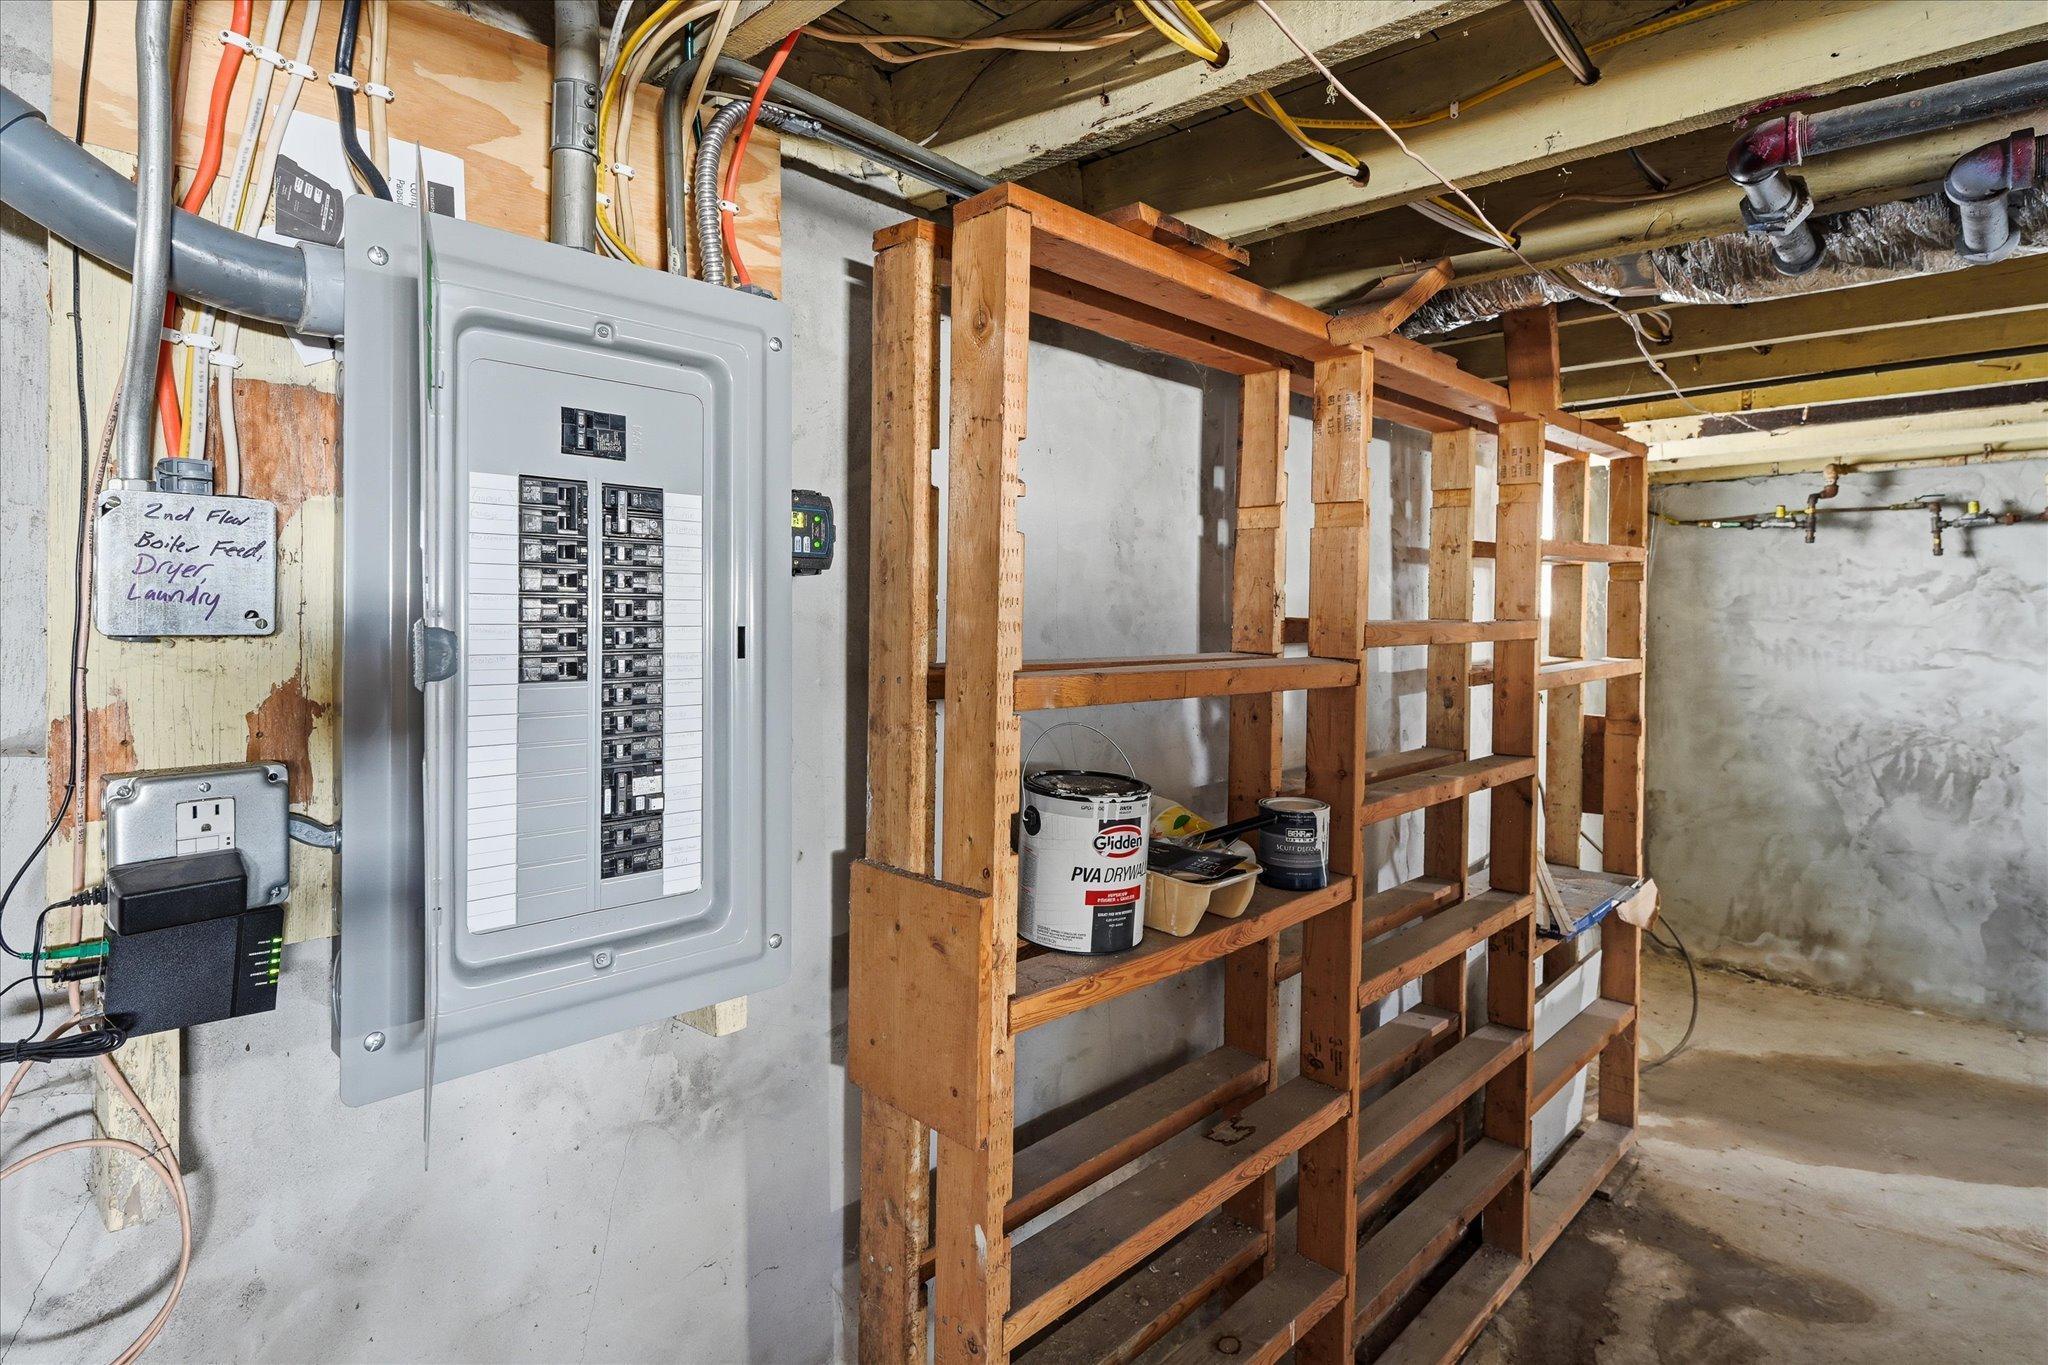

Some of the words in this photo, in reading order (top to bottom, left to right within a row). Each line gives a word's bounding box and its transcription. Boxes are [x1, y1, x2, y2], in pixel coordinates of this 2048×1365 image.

[144, 503, 195, 522] 2nd
[134, 531, 199, 553] Boiler
[127, 582, 221, 621] Laundry
[1093, 834, 1143, 851] Glidden
[1287, 830, 1306, 838] BEHR
[1071, 866, 1101, 883] PVA
